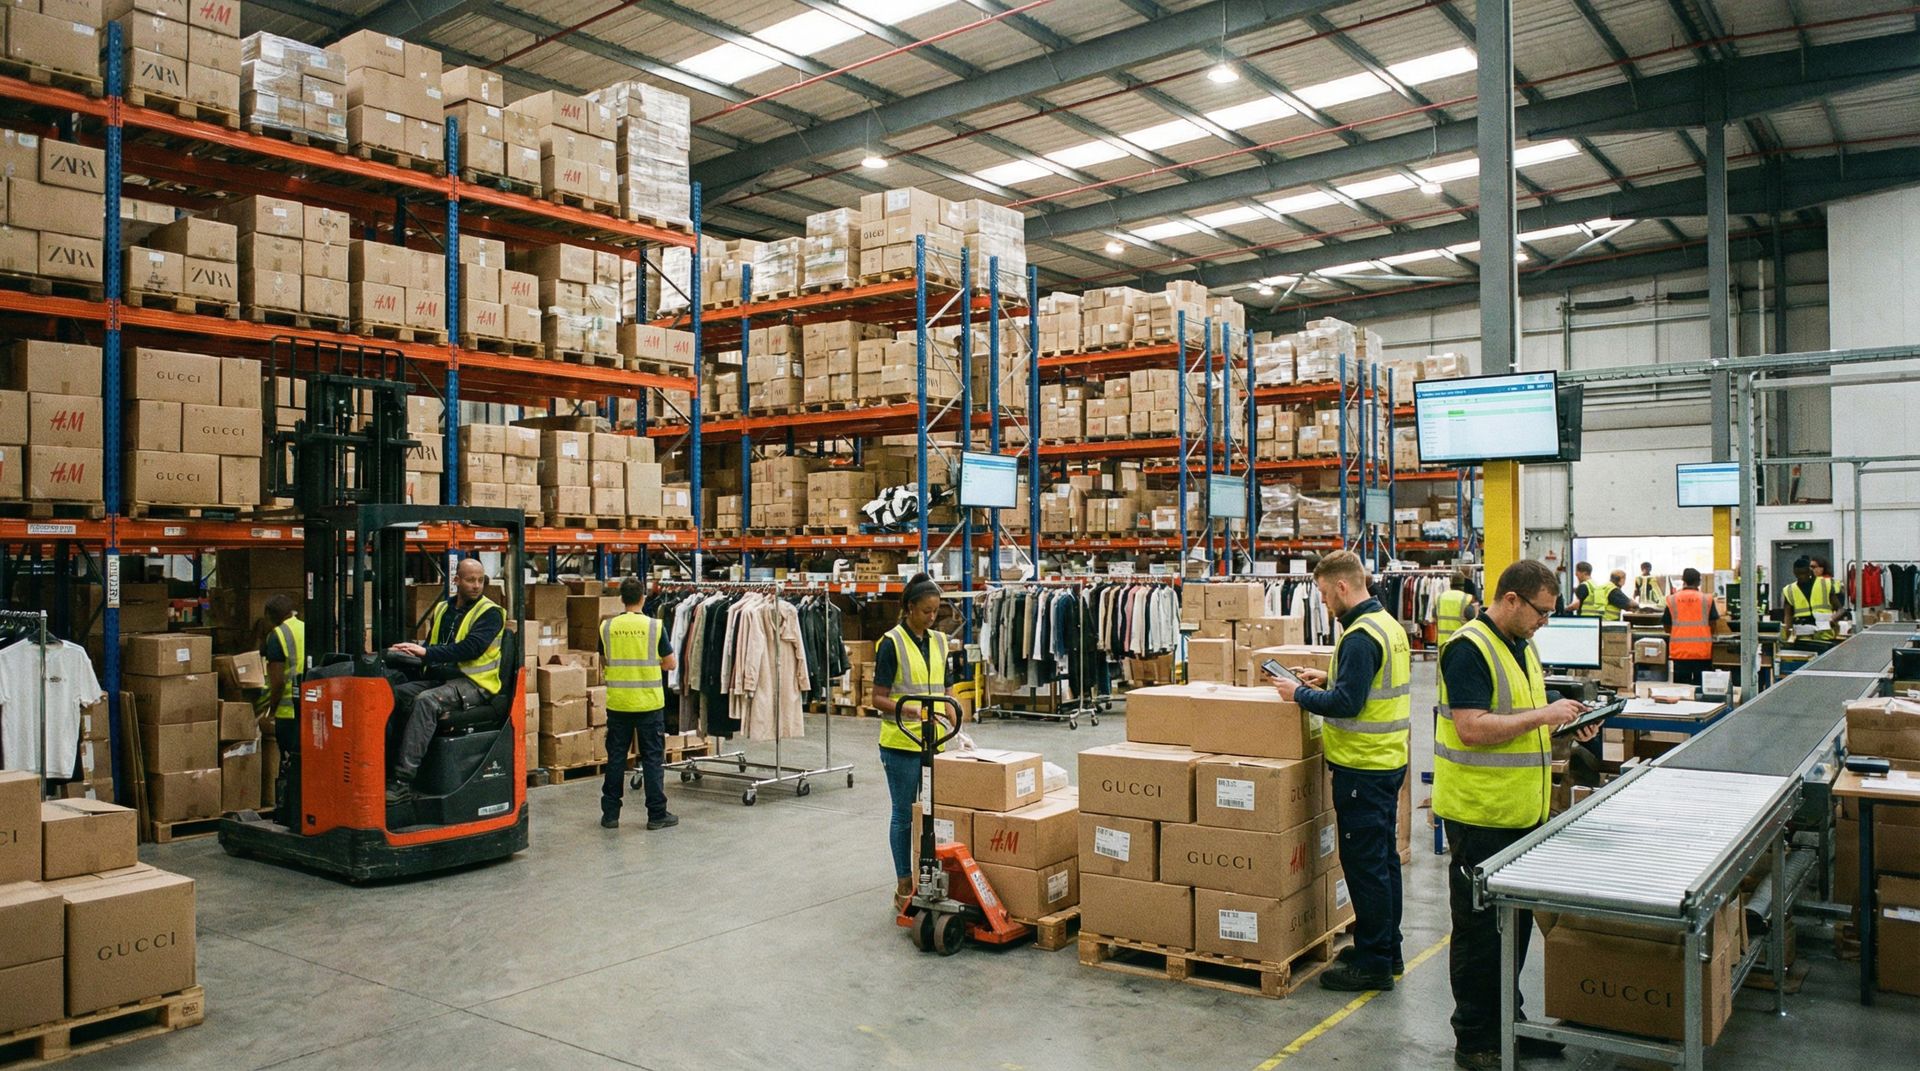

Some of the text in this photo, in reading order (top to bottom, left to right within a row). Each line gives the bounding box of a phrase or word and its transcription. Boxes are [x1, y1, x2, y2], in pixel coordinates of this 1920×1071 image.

[142, 61, 180, 86] ZARA
[51, 154, 97, 179] ZARA
[48, 244, 94, 270] ZARA
[191, 267, 232, 288] ZARA
[156, 370, 201, 384] GUCCI
[202, 425, 245, 437] GUCCI
[156, 471, 201, 483] GUCCI
[1101, 779, 1162, 798] GUCCI
[1187, 850, 1252, 870] GUCCI
[97, 931, 176, 961] GUCCI
[1580, 978, 1672, 1008] GUCCI
